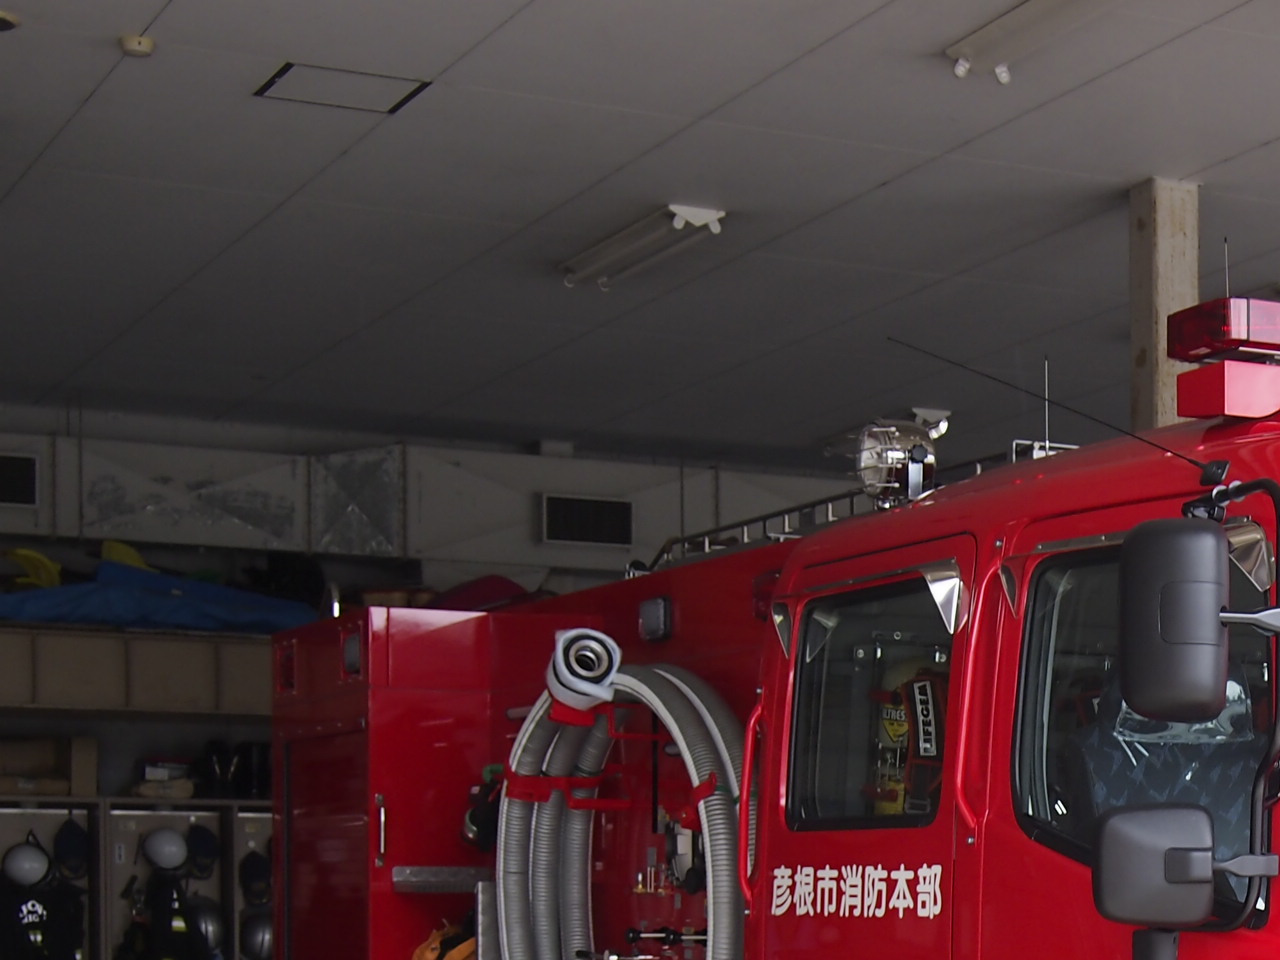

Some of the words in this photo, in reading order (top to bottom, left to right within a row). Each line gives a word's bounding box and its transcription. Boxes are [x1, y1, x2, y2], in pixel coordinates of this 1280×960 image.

[917, 683, 933, 754] LIFEGEM
[770, 863, 942, 920] 彦根市消防本部
